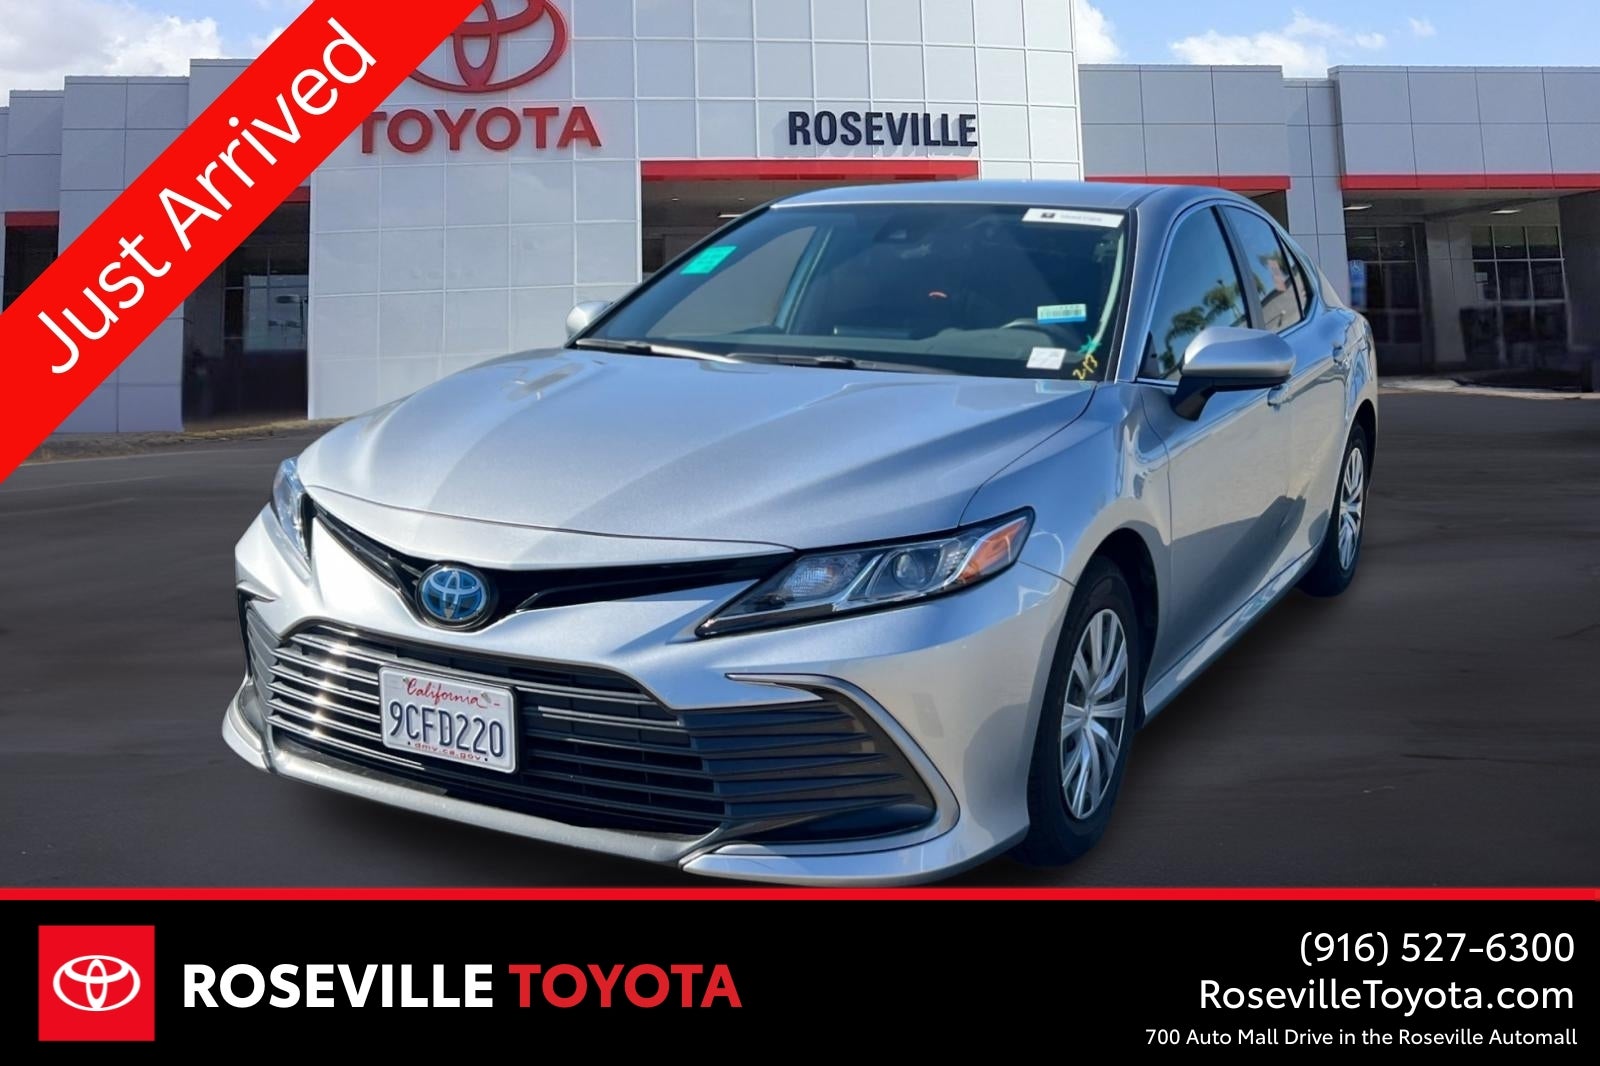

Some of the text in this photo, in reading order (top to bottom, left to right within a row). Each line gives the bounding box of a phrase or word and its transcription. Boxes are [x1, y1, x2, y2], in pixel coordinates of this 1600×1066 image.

[361, 106, 602, 154] TOYOTA
[788, 110, 978, 147] ROSEVILLE
[406, 677, 487, 709] California
[389, 700, 504, 758] 9CFD220
